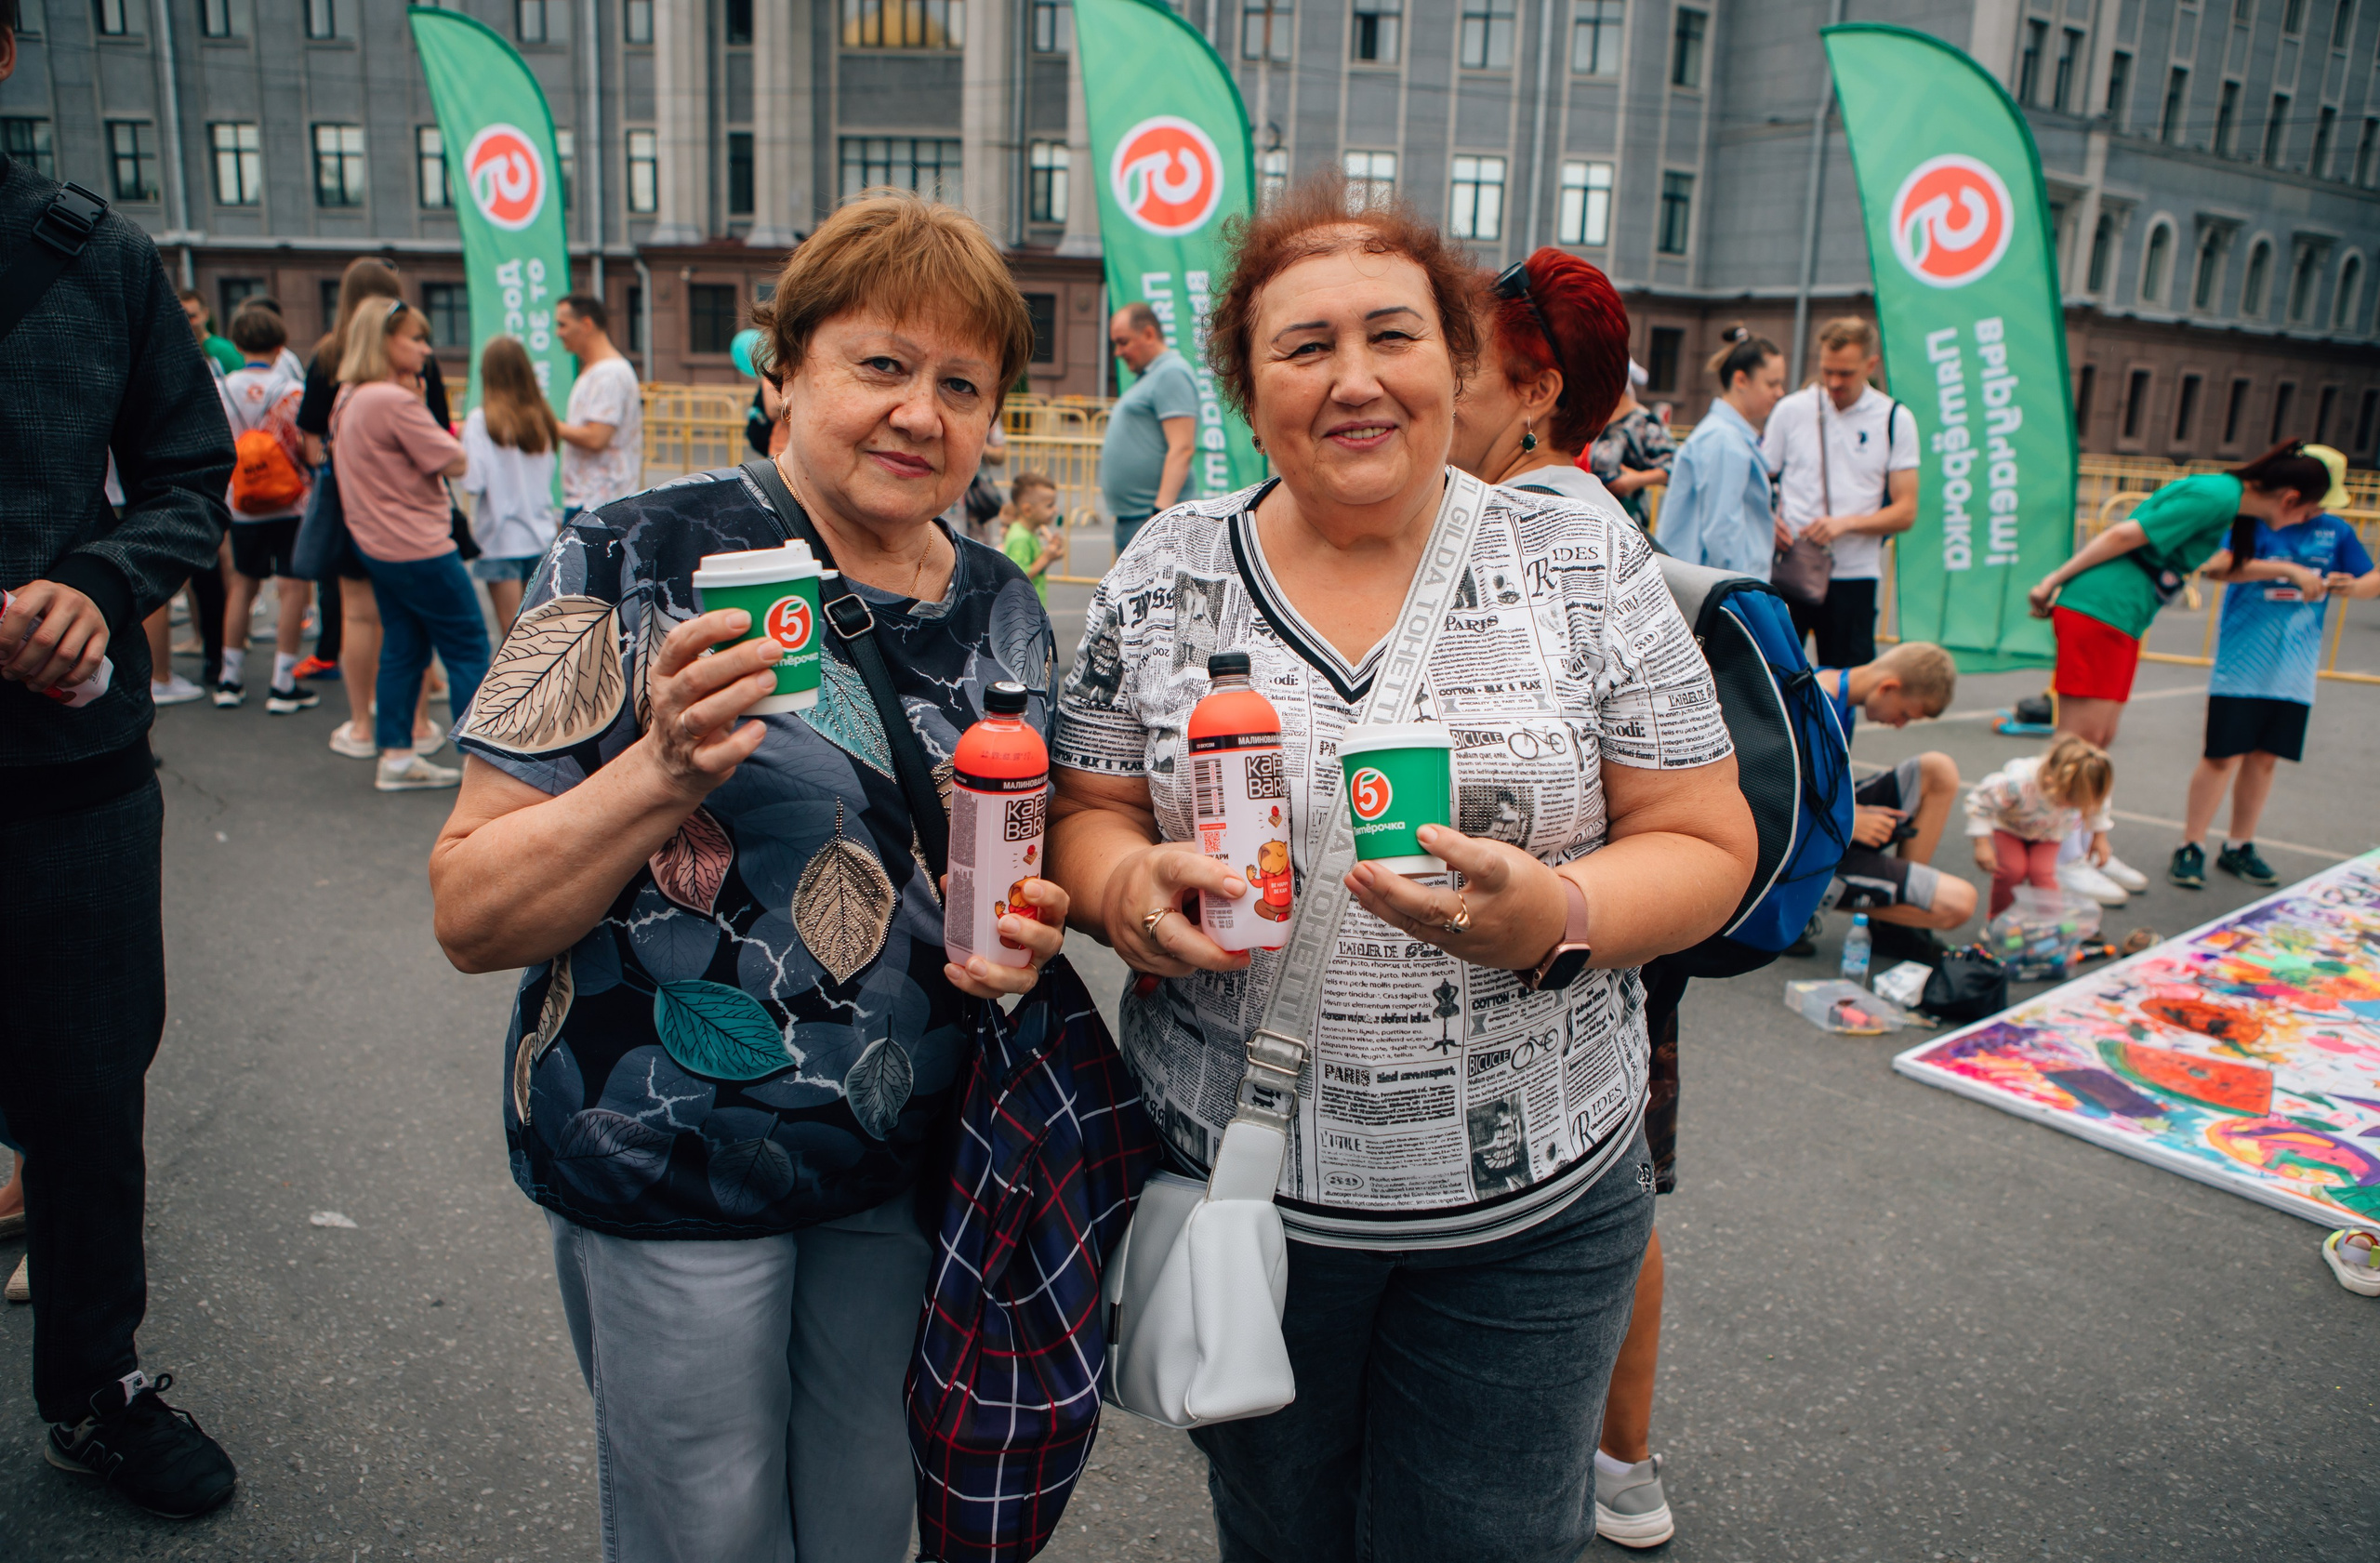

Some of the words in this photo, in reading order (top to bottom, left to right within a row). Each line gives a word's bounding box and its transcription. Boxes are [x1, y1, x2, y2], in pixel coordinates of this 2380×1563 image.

[1424, 506, 1470, 586] GILDA
[780, 600, 805, 642] 5
[1444, 615, 1499, 633] PARIS
[1438, 686, 1475, 695] COTTON
[1520, 681, 1542, 690] FLAX
[1451, 730, 1503, 749] BICUCLE
[1358, 772, 1380, 811] 5
[1324, 988, 1347, 998] Integer
[1472, 990, 1510, 1010] COTTON
[1352, 1000, 1390, 1010] elementum
[1469, 1051, 1509, 1077] BICUCLE
[1324, 1063, 1370, 1087] PARIS
